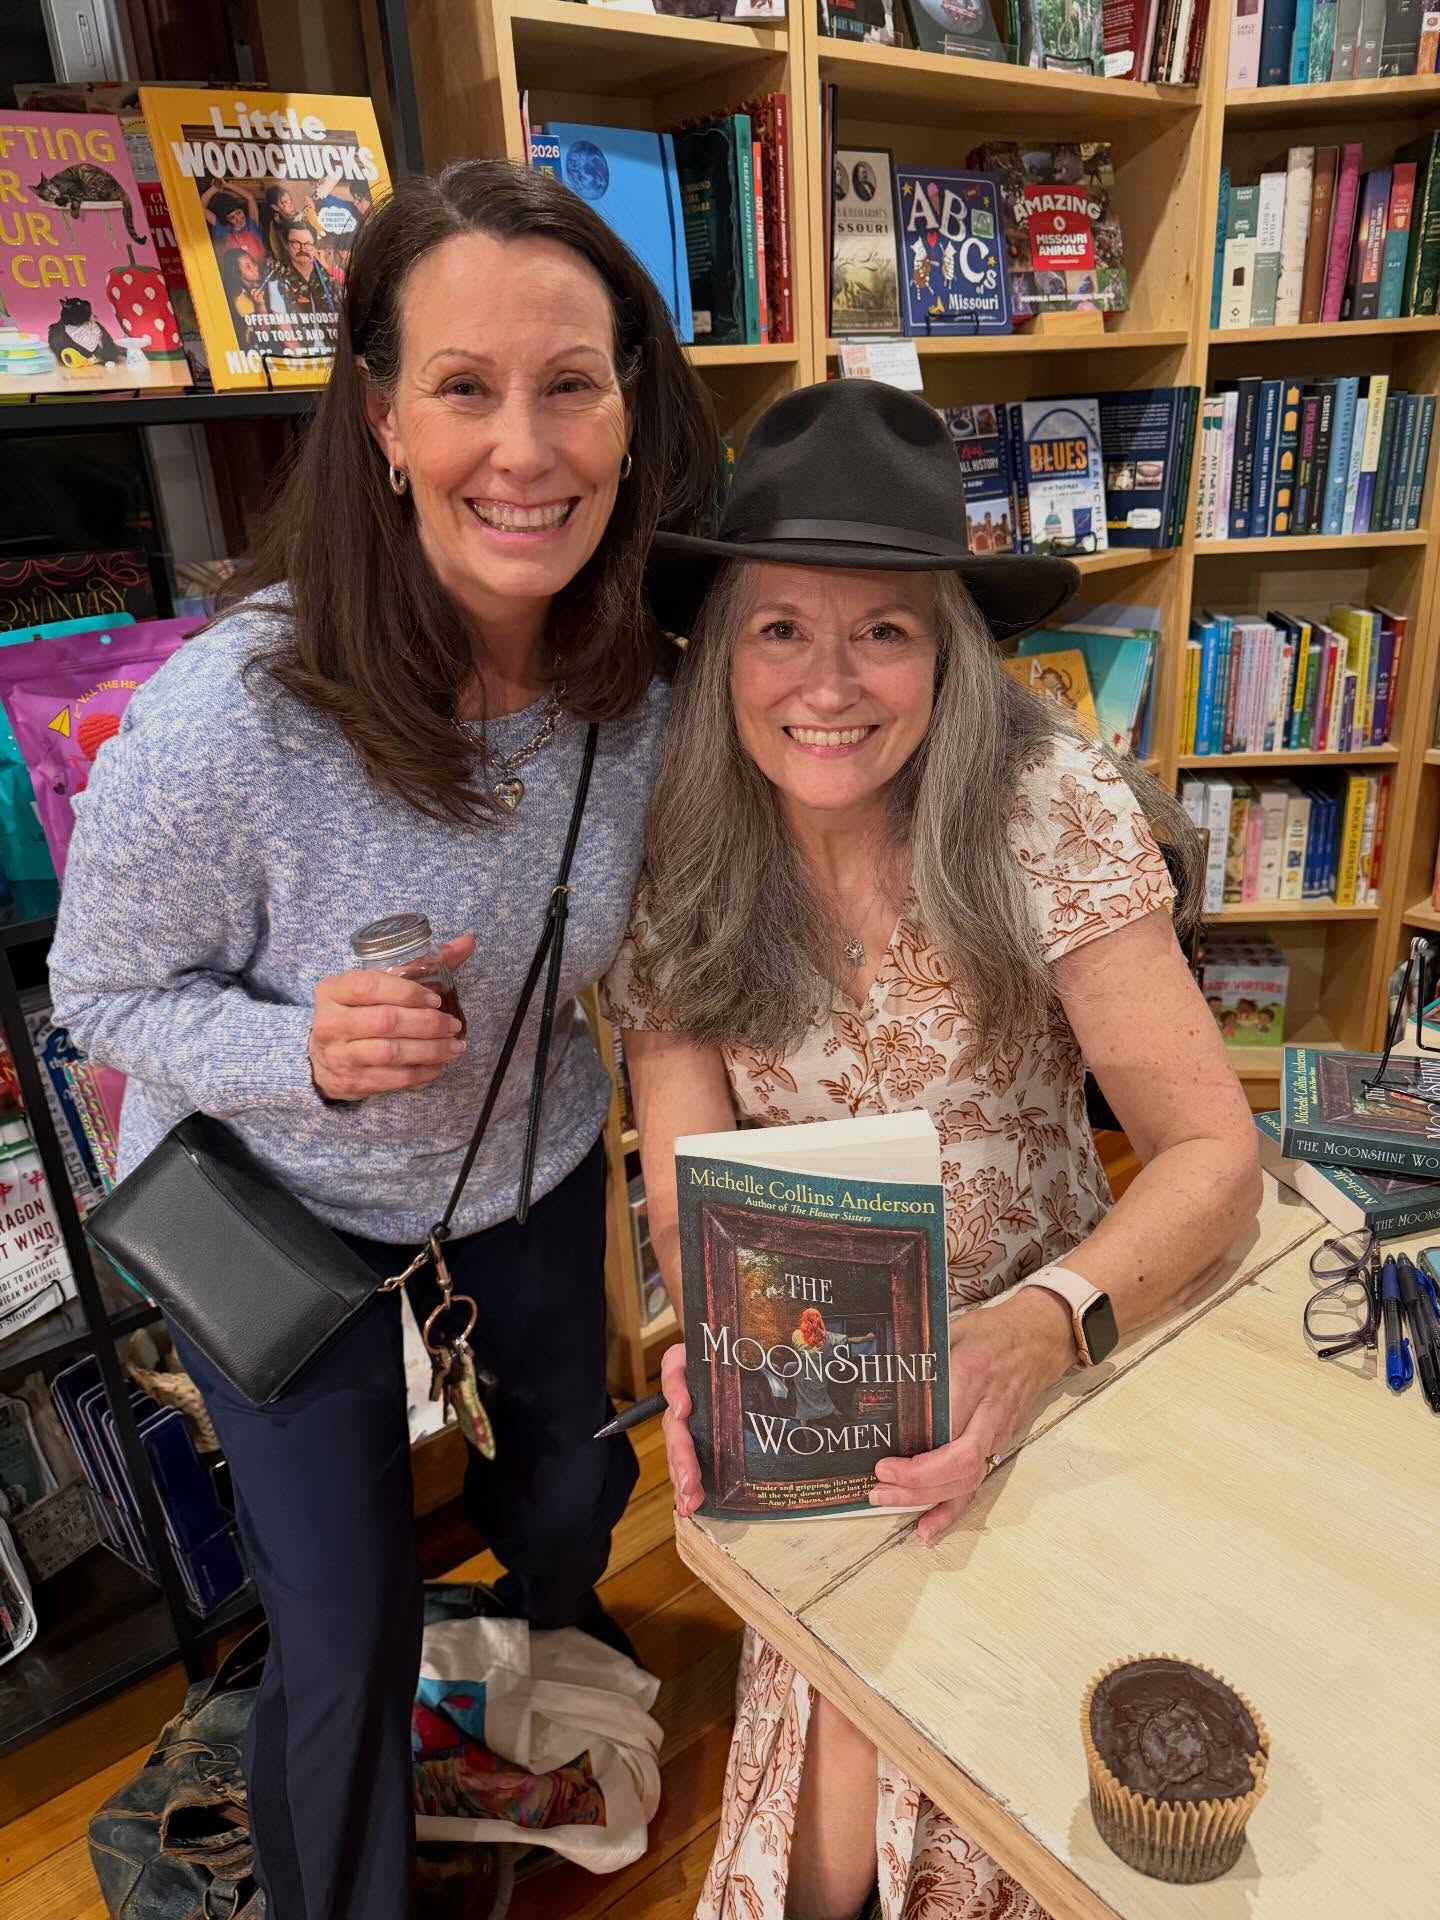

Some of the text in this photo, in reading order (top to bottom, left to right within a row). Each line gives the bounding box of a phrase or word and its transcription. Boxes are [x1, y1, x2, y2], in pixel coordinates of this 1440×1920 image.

[208, 102, 328, 141] Little
[171, 140, 380, 182] WOODCHUCKS
[531, 144, 560, 158] 2026
[1013, 194, 1102, 222] AMAZING
[1035, 233, 1088, 245] MISSOURI
[1038, 244, 1086, 257] ANIMALS
[11, 253, 87, 289] CAT
[948, 293, 1000, 311] Missouri
[245, 313, 298, 326] OFFERMAN
[255, 332, 269, 342] TO
[271, 329, 303, 342] TOOLS
[306, 328, 325, 341] AND
[971, 457, 1000, 472] HISTORY
[1029, 440, 1088, 473] BLUES
[95, 679, 120, 692] THE
[1292, 1049, 1309, 1125] Michelle Collins Anderson
[1296, 1139, 1319, 1152] THE
[1324, 1141, 1406, 1164] MOONSHINE
[689, 1168, 937, 1214] Michelle Collins Anderson
[1332, 1168, 1379, 1206] Michelle
[745, 1197, 872, 1223] Author of The Flower Sisters
[14, 1220, 55, 1253] WIND
[1375, 1217, 1395, 1232] THE
[14, 1274, 24, 1285] TO
[26, 1256, 58, 1280] OFFICIAL
[784, 1272, 833, 1305] THE
[699, 1321, 937, 1384] MOONSHINE
[744, 1410, 893, 1456] WOMEN
[795, 1483, 831, 1492] gripping,
[833, 1479, 847, 1487] this
[849, 1476, 868, 1485] story
[800, 1489, 821, 1497] down
[798, 1497, 824, 1505] Burns,
[825, 1493, 850, 1502] author
